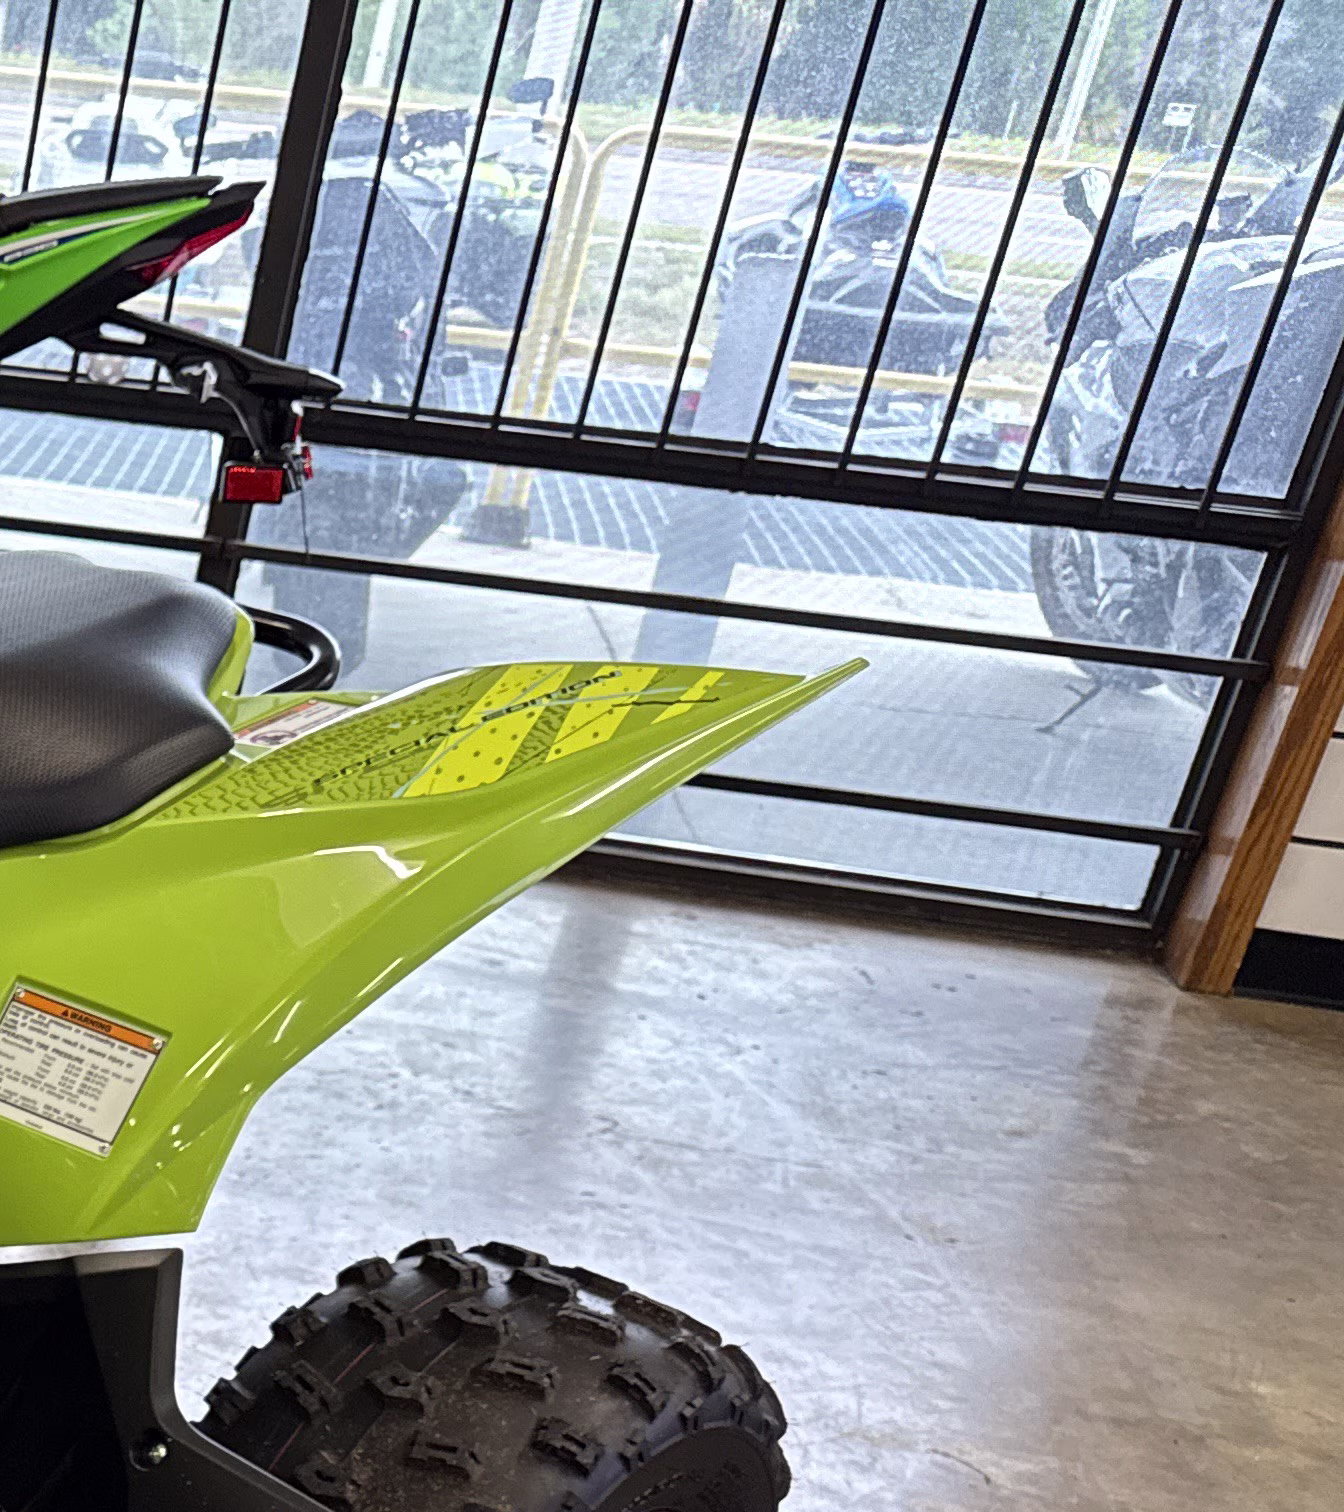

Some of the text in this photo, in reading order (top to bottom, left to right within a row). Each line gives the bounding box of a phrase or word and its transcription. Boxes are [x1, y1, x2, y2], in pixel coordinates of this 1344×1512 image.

[313, 722, 477, 787] SPECIAL
[481, 671, 622, 722] EDITION
[68, 1010, 114, 1033] WARNING
